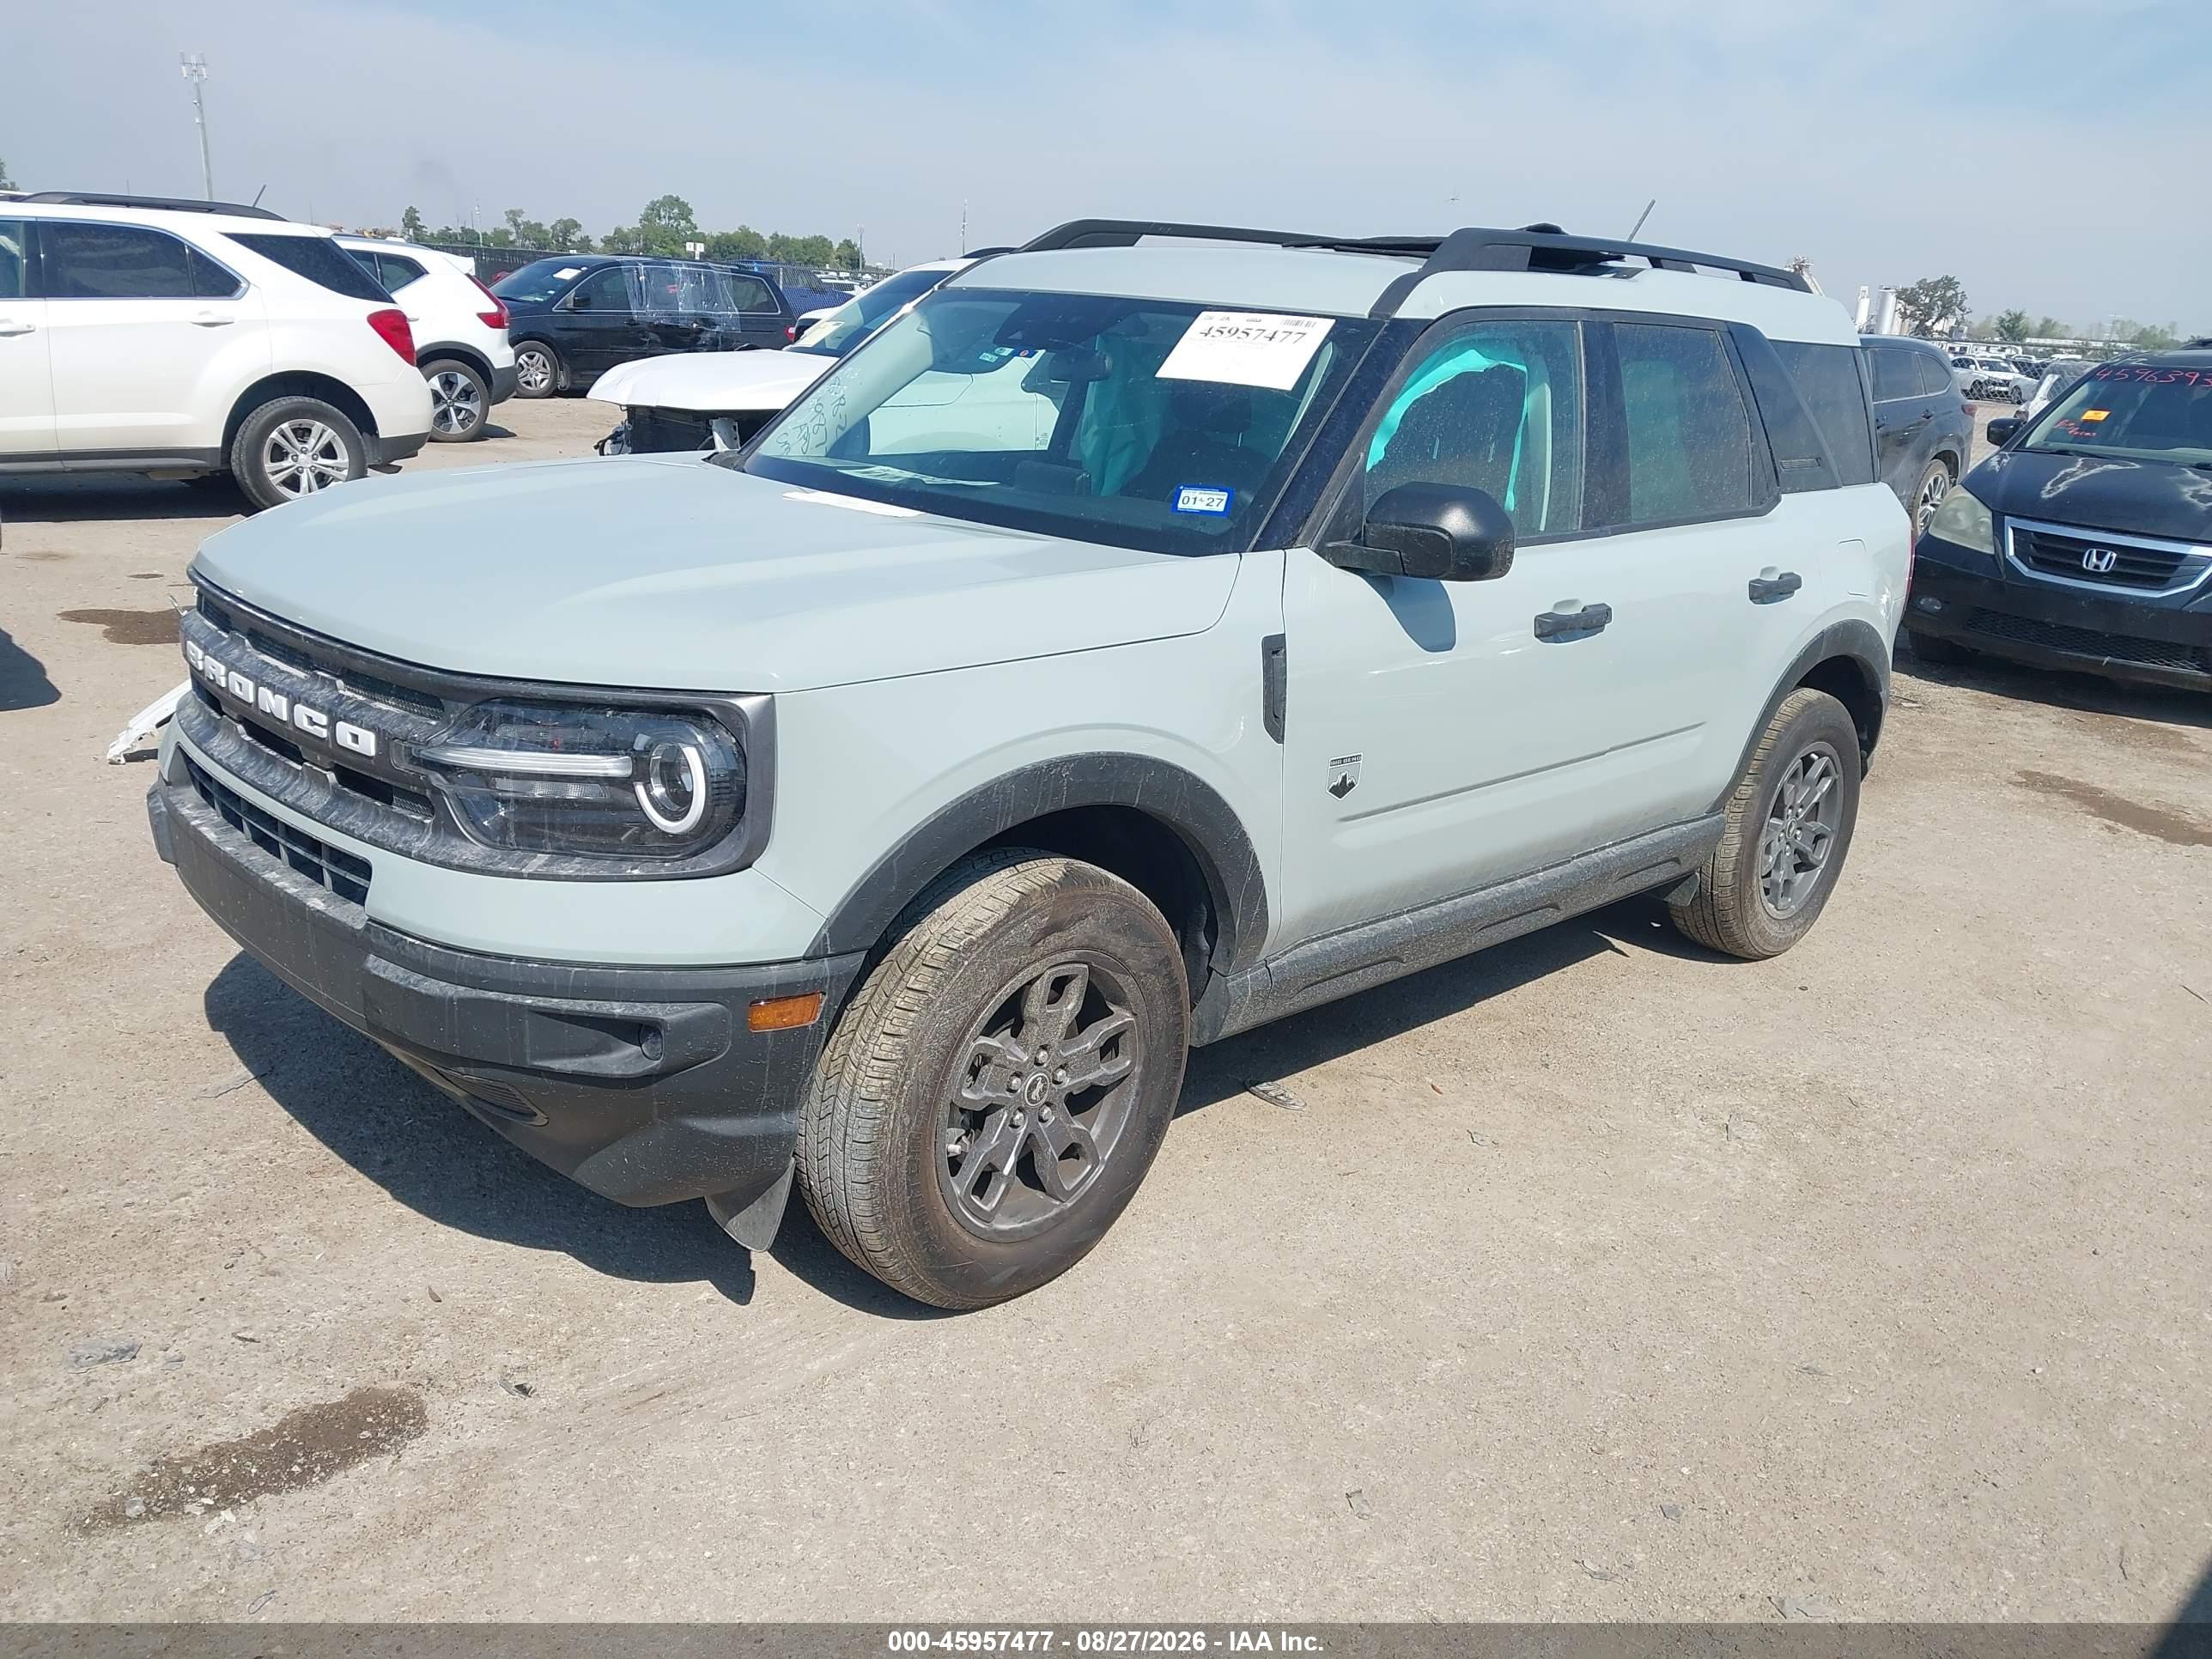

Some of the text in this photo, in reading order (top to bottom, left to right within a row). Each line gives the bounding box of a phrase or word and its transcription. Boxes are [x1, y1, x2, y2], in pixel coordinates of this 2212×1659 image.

[1200, 325, 1307, 343] 45957477
[1182, 495, 1224, 507] 01 27
[186, 641, 375, 757] BRONCO
